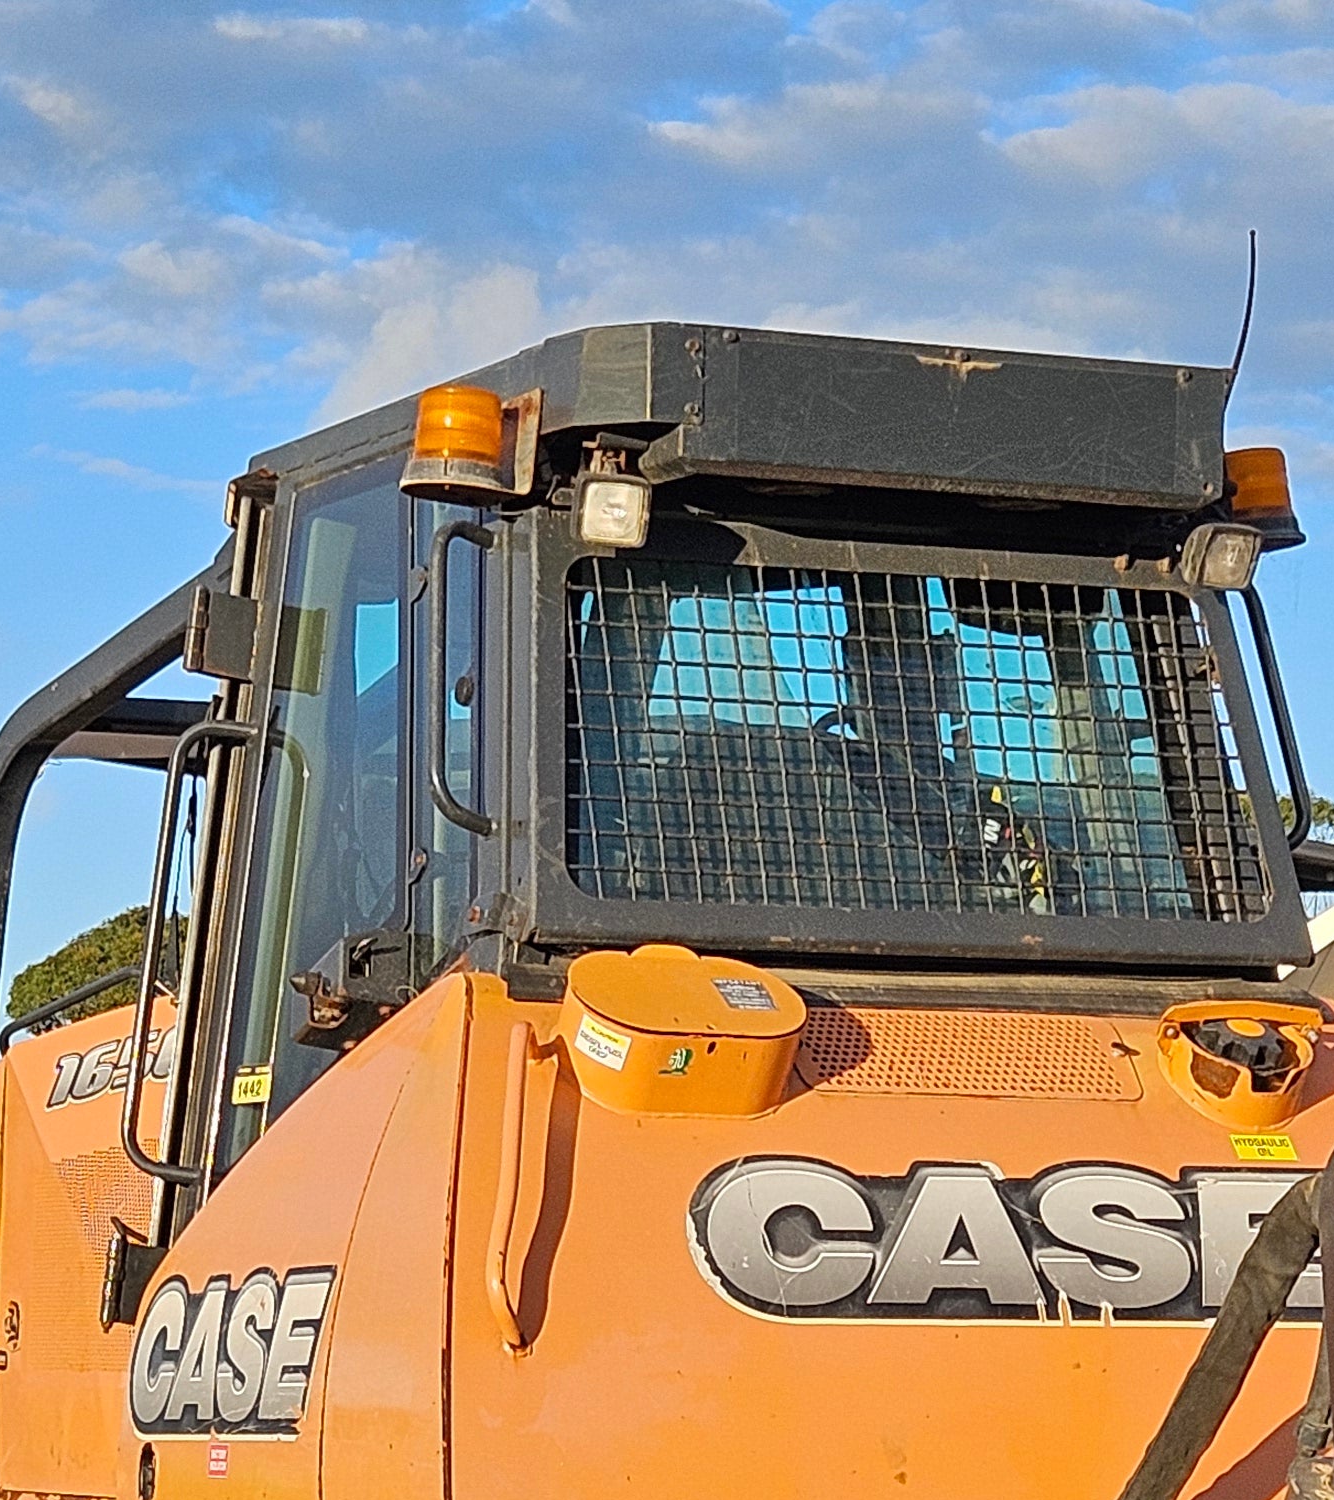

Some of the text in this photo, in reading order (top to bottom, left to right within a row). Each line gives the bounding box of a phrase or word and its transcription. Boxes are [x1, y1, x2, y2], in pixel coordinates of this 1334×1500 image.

[238, 1078, 263, 1097] 1442
[697, 1165, 1325, 1311] CASE
[131, 1270, 336, 1425] CASE
